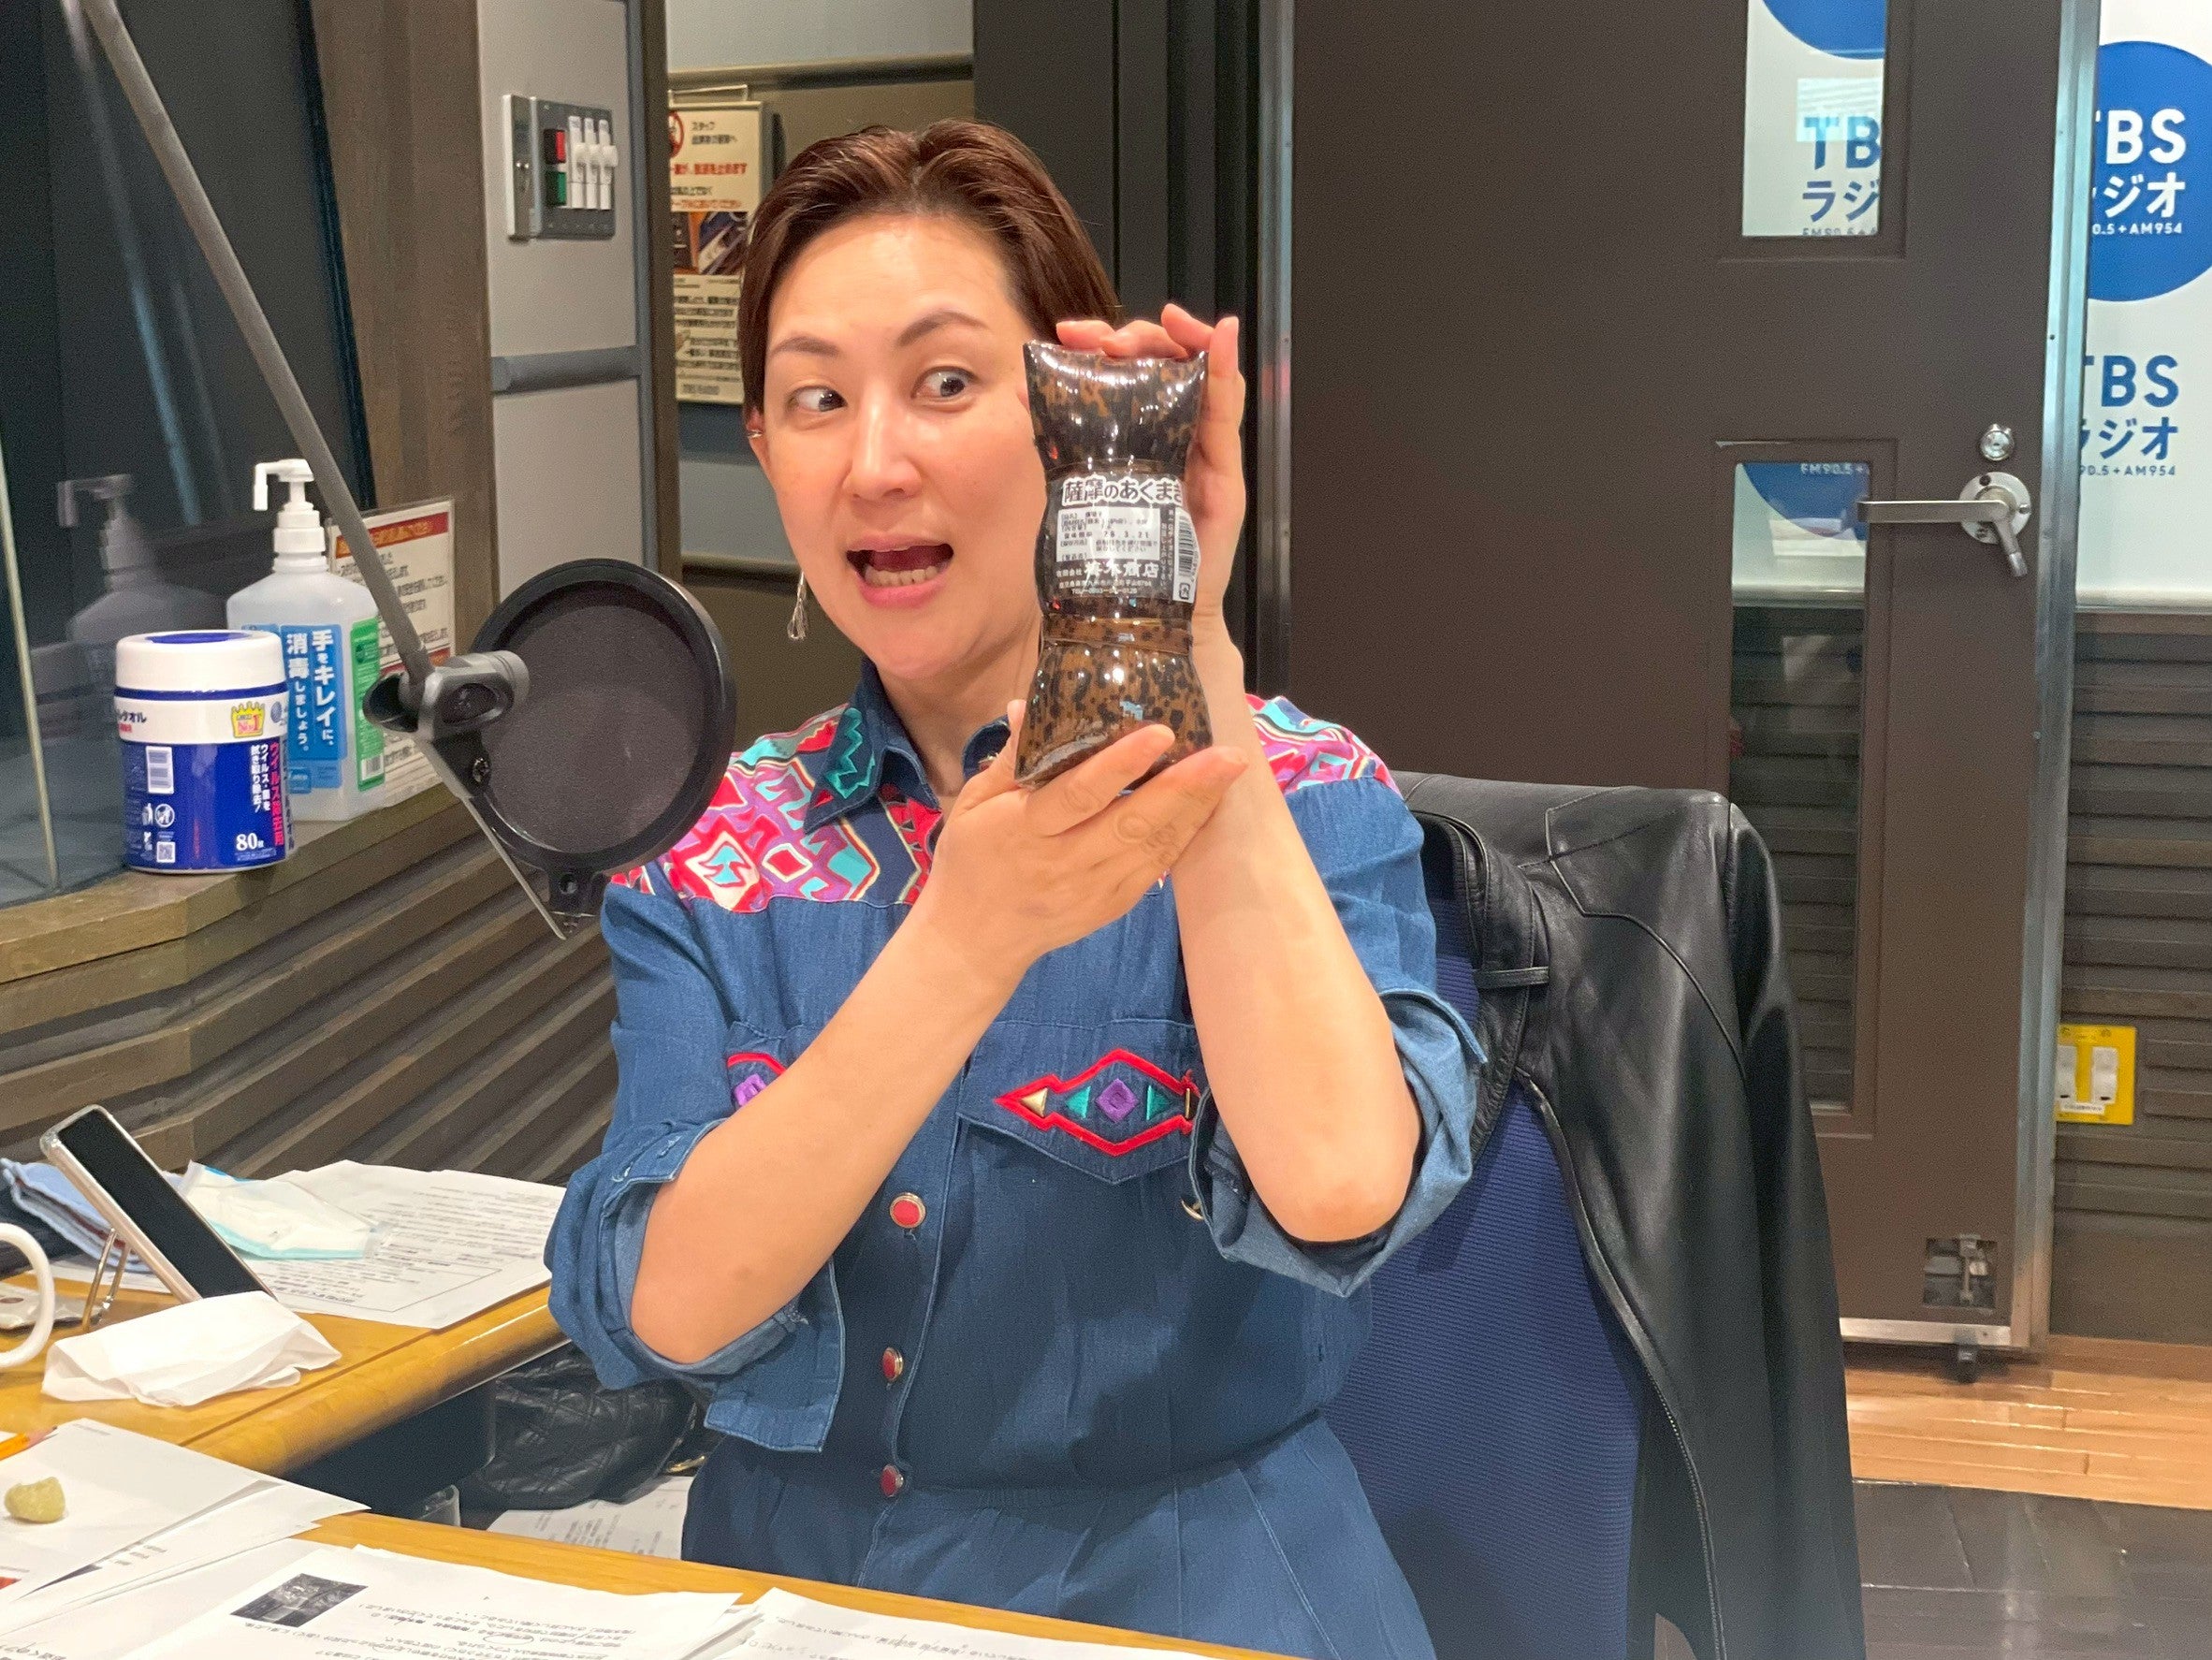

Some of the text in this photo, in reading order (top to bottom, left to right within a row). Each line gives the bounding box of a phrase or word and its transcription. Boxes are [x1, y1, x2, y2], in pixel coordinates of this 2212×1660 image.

[1803, 115, 1882, 170] TB
[2095, 108, 2187, 165] BS
[2092, 171, 2186, 218] ジオ
[2082, 354, 2179, 408] BS
[2080, 415, 2179, 460] ジオ
